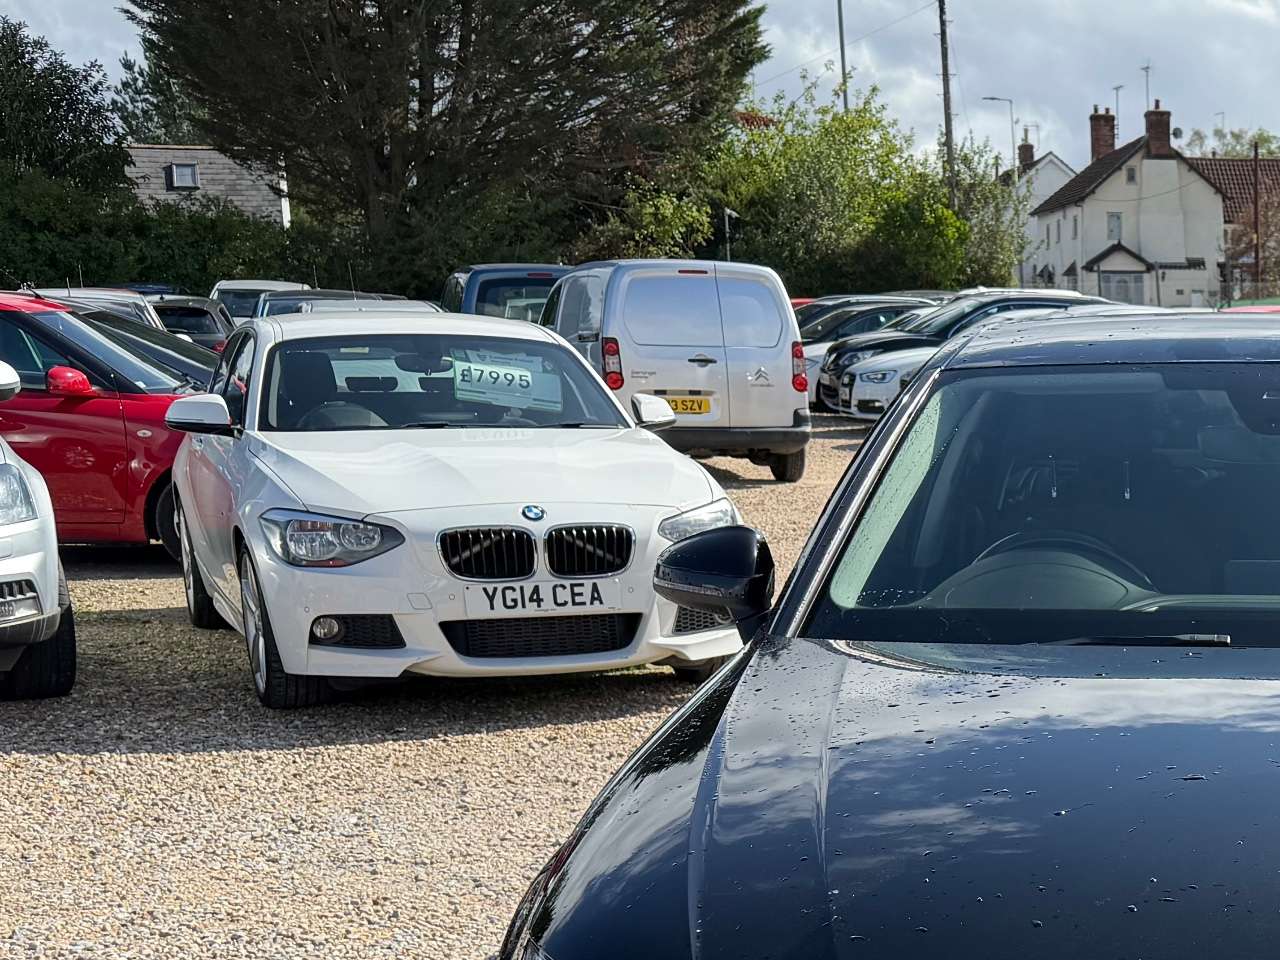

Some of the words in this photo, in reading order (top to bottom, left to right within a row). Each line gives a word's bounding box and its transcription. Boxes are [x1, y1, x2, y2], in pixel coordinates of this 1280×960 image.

[460, 366, 531, 389] £7995
[680, 399, 704, 412] SZV
[482, 584, 545, 611] YG14
[551, 582, 604, 608] CEA
